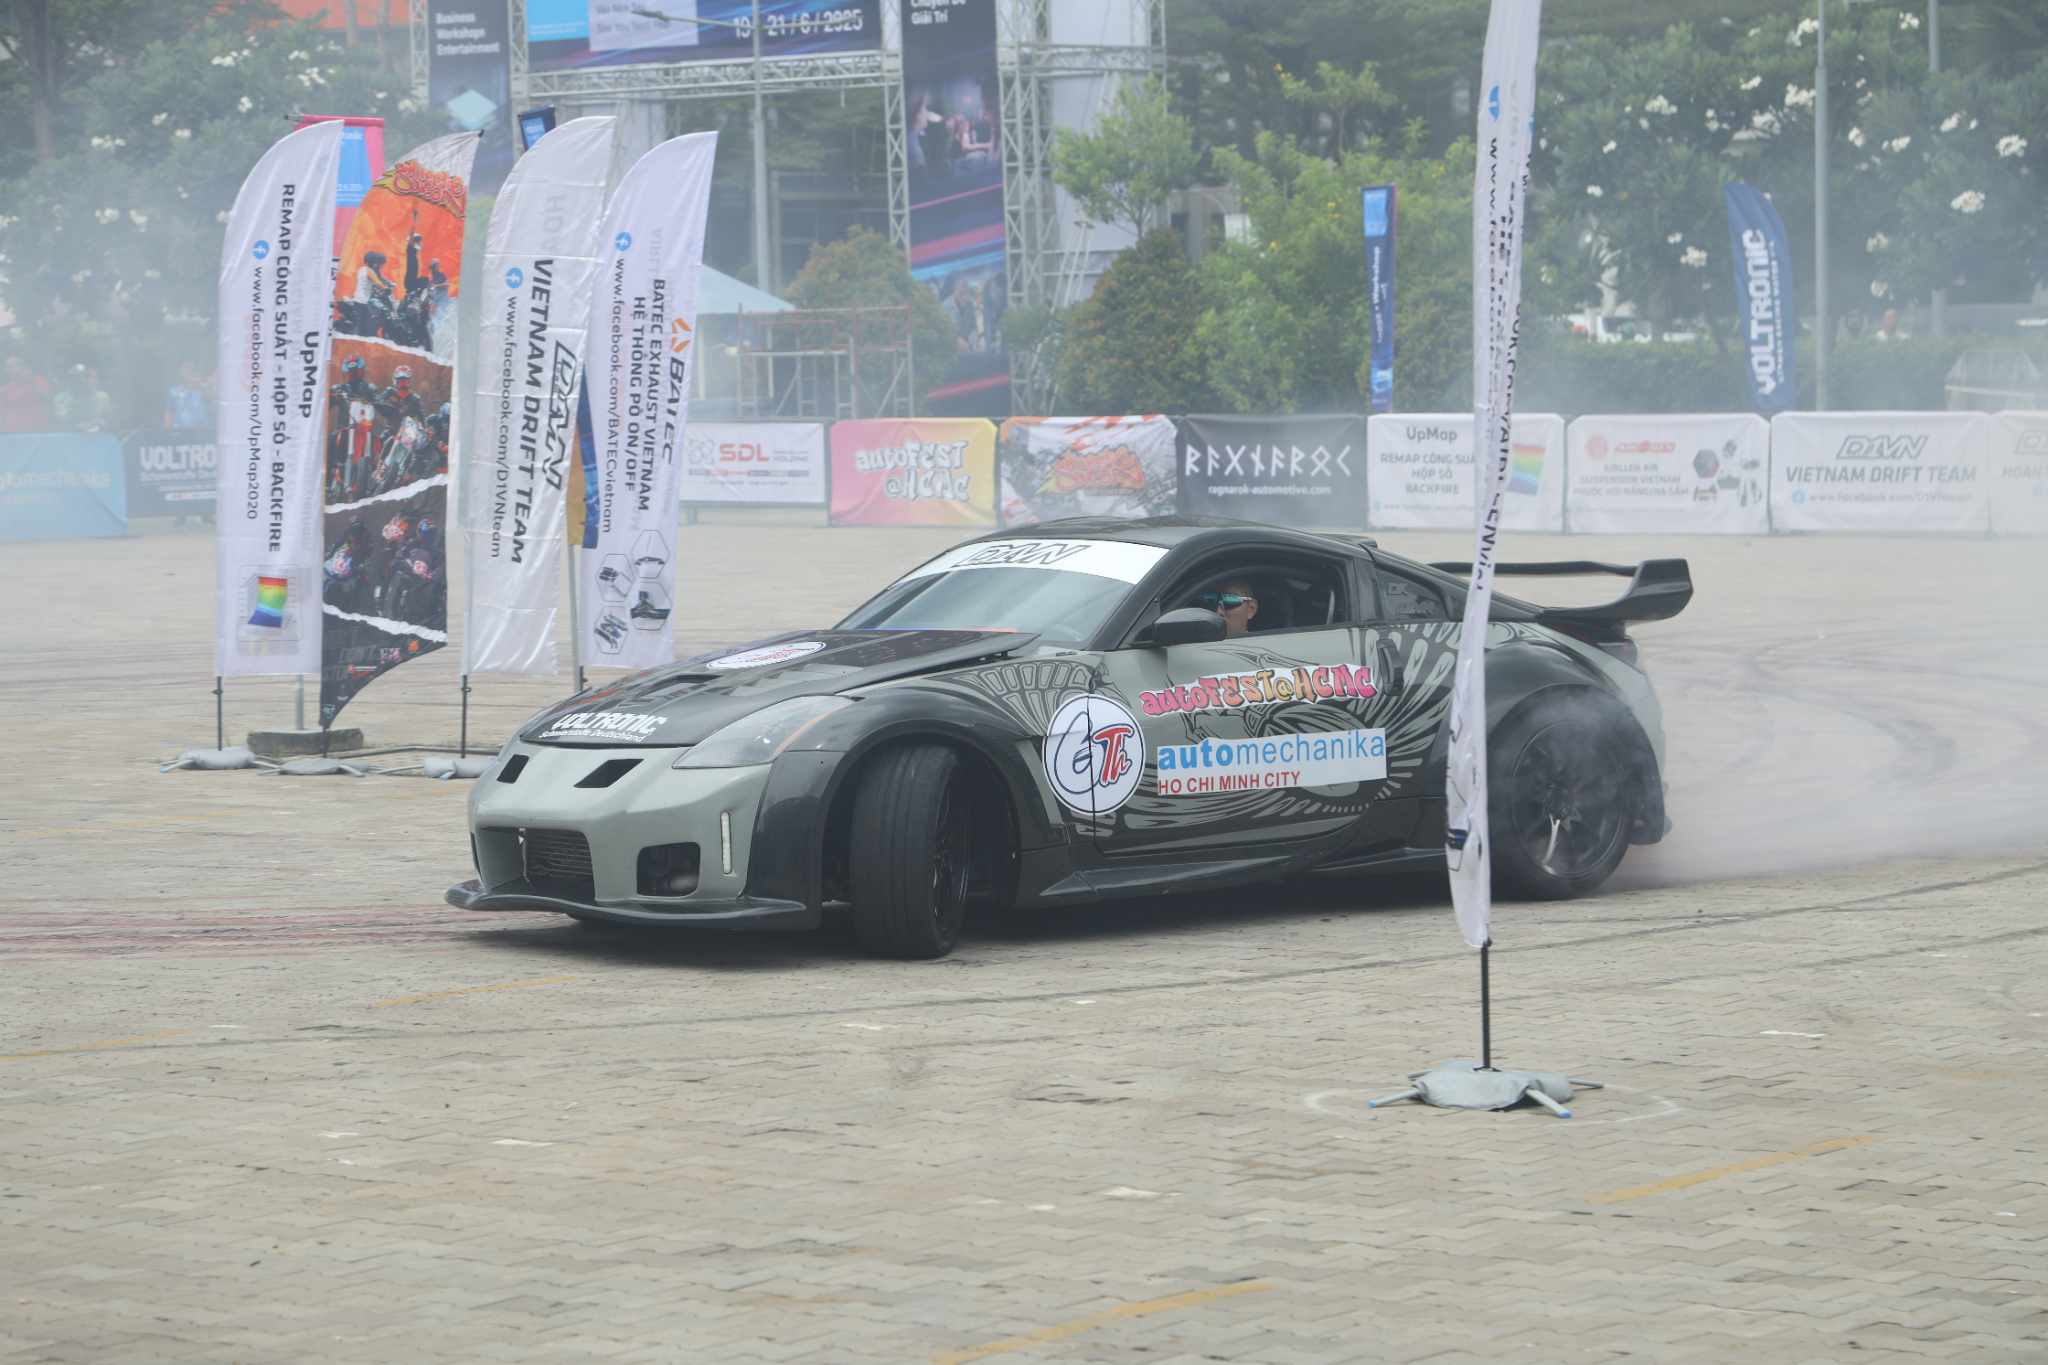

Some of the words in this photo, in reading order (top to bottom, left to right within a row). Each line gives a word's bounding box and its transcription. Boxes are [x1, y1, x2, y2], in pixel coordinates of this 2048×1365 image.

[435, 12, 476, 24] Business
[437, 43, 499, 55] Entertainment
[279, 184, 296, 248] REMAP
[275, 256, 291, 306] CÔNG
[631, 297, 647, 320] HỆ
[651, 279, 666, 334] BATEC
[525, 260, 554, 388] VIETNAM
[1742, 229, 1777, 395] VOLTRONIC
[246, 267, 264, 519] www.facebook.com/UpMap2020
[271, 377, 289, 416] HỘP
[298, 332, 320, 418] UpMap
[602, 258, 624, 533] www.facebook.com/BATECvietnam
[646, 339, 662, 422] EXHAUST
[491, 296, 518, 557] www.facebook.com/D1VNteam
[518, 395, 542, 480] DRIFT
[720, 443, 769, 462] SDL
[1406, 427, 1458, 443] UpMap
[625, 422, 640, 491] ON/OFF
[638, 428, 656, 511] VIETNAM
[1380, 453, 1420, 464] REMAP
[1786, 466, 1865, 483] VIETNAM
[1869, 466, 1922, 482] DRIFT
[1928, 466, 1977, 482] TEAM
[268, 462, 285, 552] BACKFIRE
[1405, 484, 1459, 495] BACKFIRE
[511, 488, 533, 564] TEAM
[551, 712, 668, 734] VOLTRONIC
[1158, 729, 1384, 770] automechanika
[1159, 778, 1182, 795] HO
[1187, 776, 1214, 793] CHI
[1219, 773, 1260, 791] MINH
[1264, 771, 1301, 788] CITY
